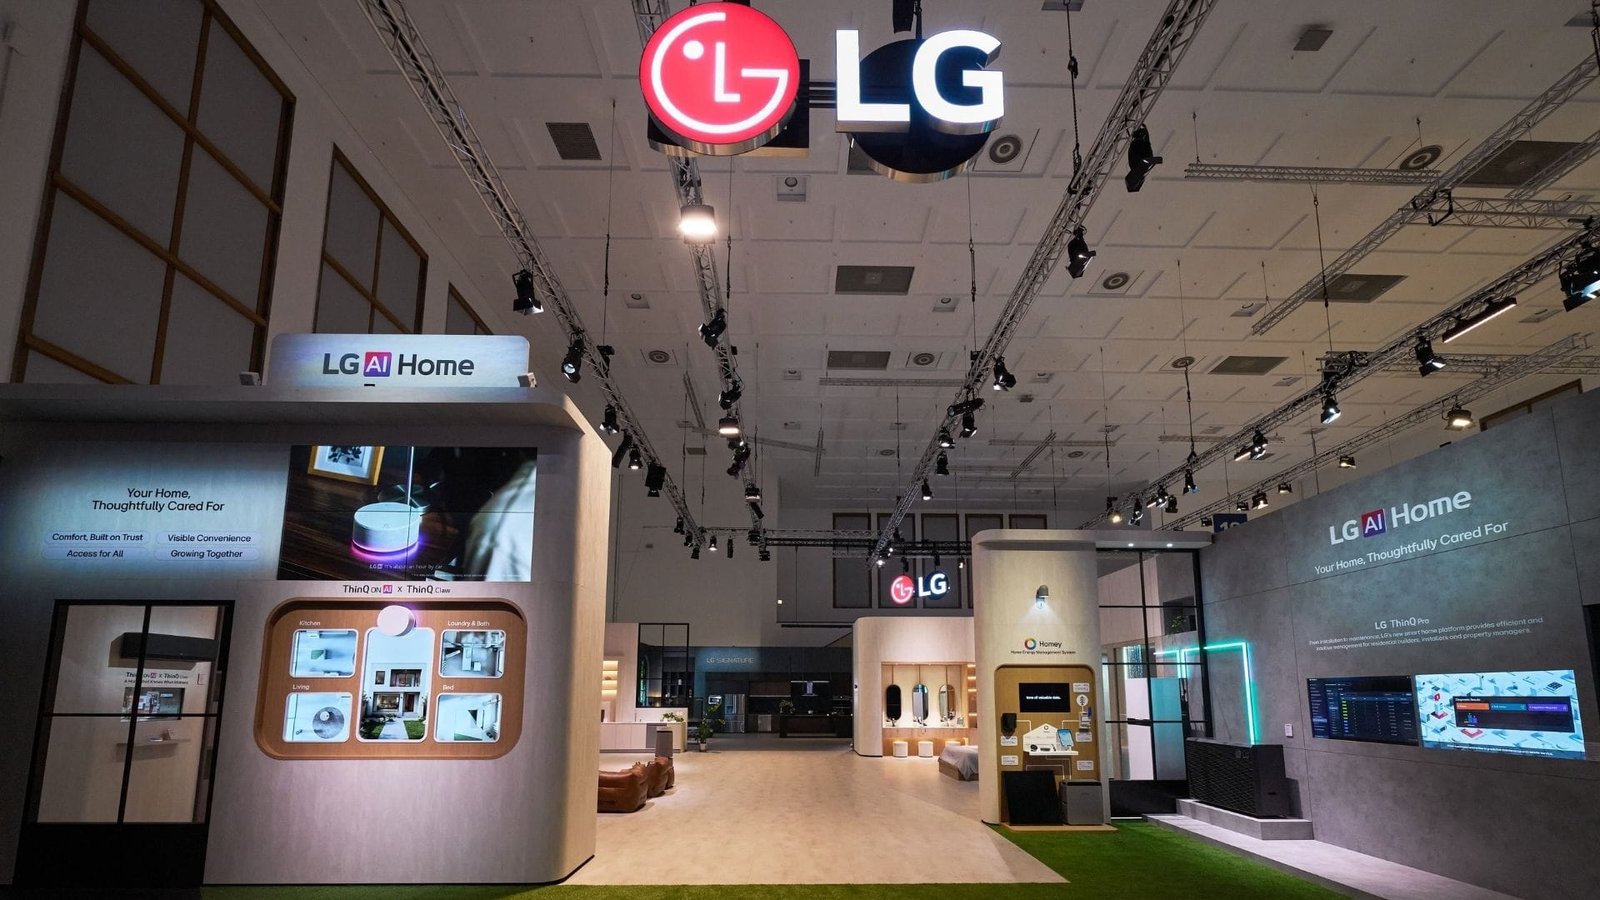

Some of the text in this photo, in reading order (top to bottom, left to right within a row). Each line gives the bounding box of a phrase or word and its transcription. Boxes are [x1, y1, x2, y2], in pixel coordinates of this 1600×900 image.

[835, 29, 1005, 124] LG
[322, 352, 475, 376] LG AI Home
[127, 487, 191, 500] Your Home,
[92, 500, 225, 513] Thoughtfully Cared For
[1329, 490, 1472, 546] LG AI Home
[51, 533, 89, 542] Comfort,
[89, 533, 109, 541] Built
[122, 533, 144, 541] Trust
[167, 534, 252, 543] Visible Convenience
[66, 549, 124, 558] Access for All
[1314, 521, 1509, 575] Your Home, Thoughtfully Cared For
[170, 550, 243, 560] Growing Together
[343, 584, 370, 594] ThinQ
[407, 585, 434, 595] ThinQ
[918, 573, 947, 597] LG
[1374, 616, 1430, 630] LG ThinQ Pro
[1438, 626, 1466, 634] platform
[1465, 622, 1495, 631] provides
[1496, 618, 1527, 627] efficient
[1462, 630, 1492, 639] property
[1039, 640, 1063, 648] Homey
